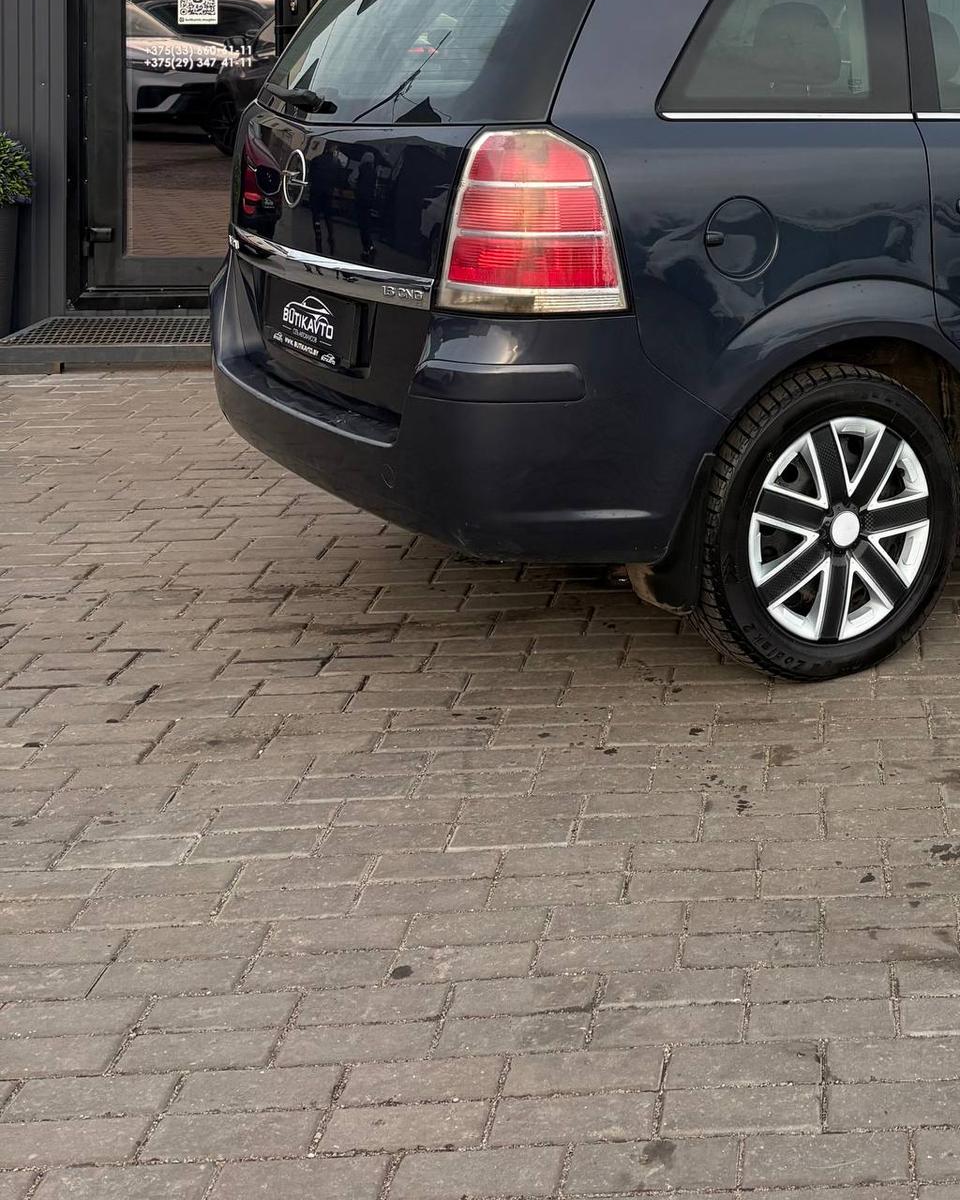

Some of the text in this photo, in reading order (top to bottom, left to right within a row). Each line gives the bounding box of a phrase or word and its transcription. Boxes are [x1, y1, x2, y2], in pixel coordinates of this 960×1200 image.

[196, 45, 252, 56] 66061-11
[144, 58, 194, 70] +375(29)
[282, 307, 334, 340] BUTIKAVTO
